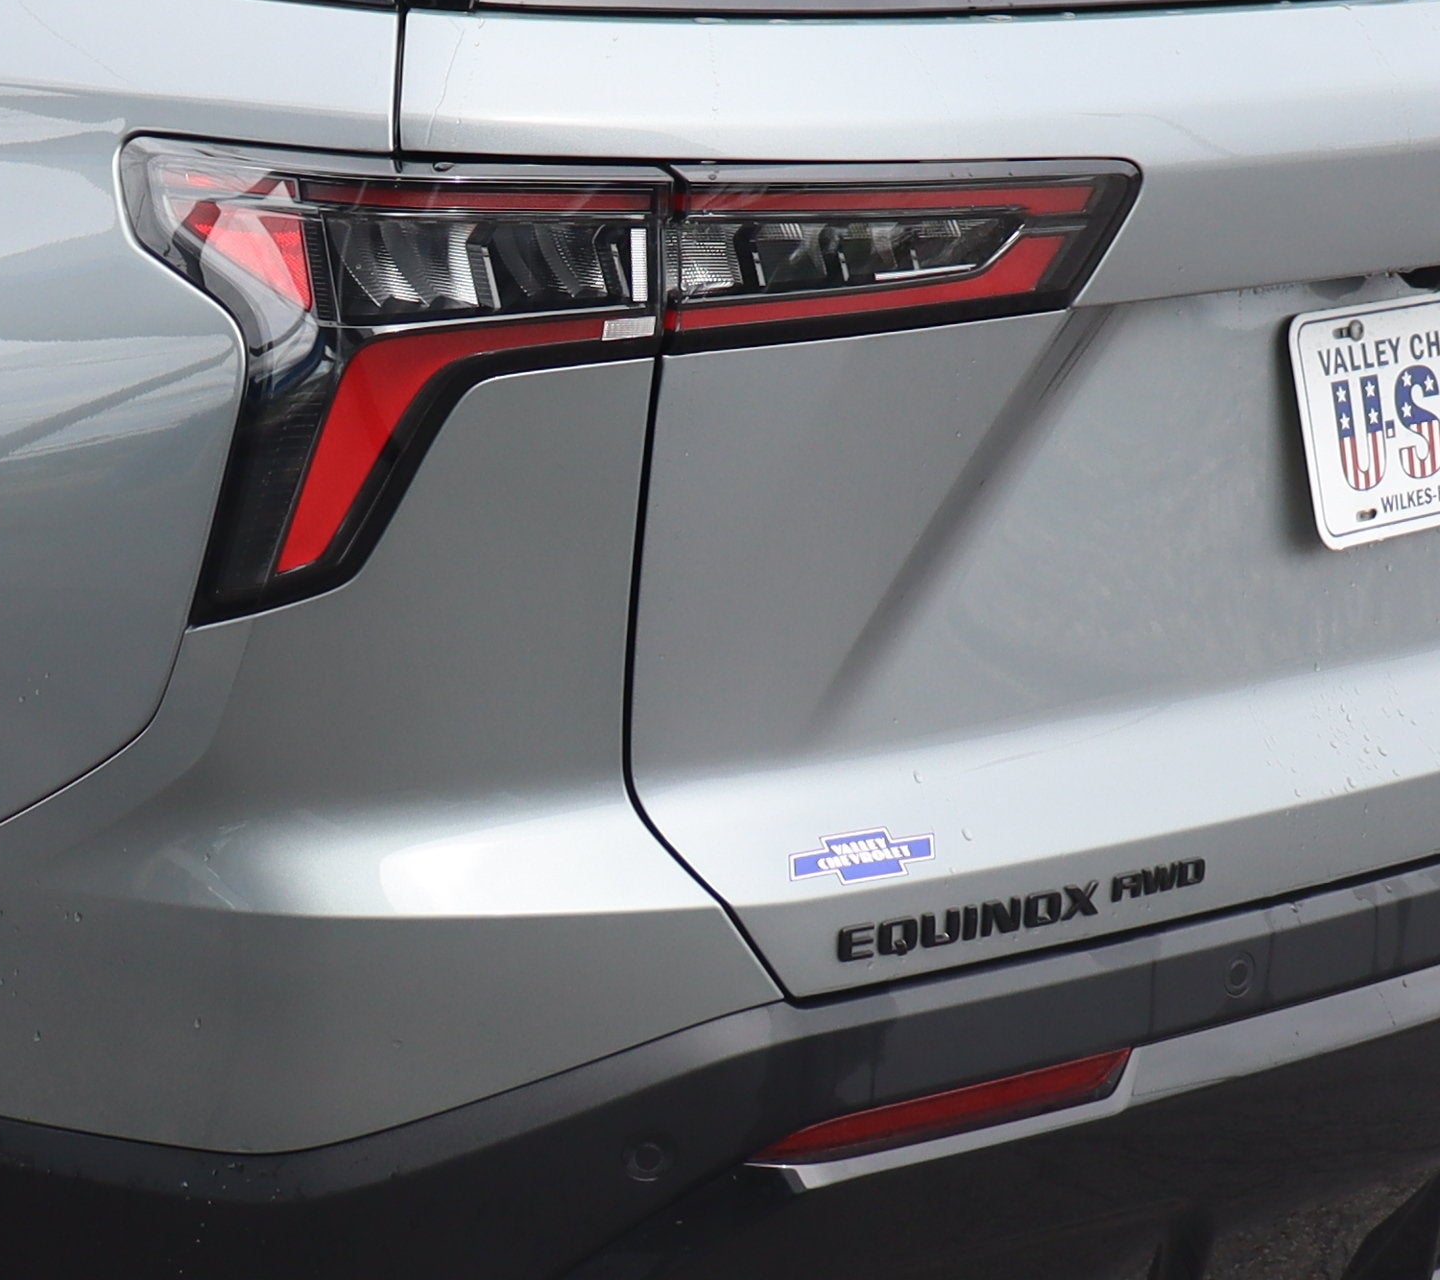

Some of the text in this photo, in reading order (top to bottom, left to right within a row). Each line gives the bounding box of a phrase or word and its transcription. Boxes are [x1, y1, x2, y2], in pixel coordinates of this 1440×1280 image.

[1318, 335, 1402, 376] VALLEY
[817, 845, 911, 870] CHEVROLET
[830, 837, 887, 856] VALLEY
[836, 857, 1205, 963] EQUINOX AWD
